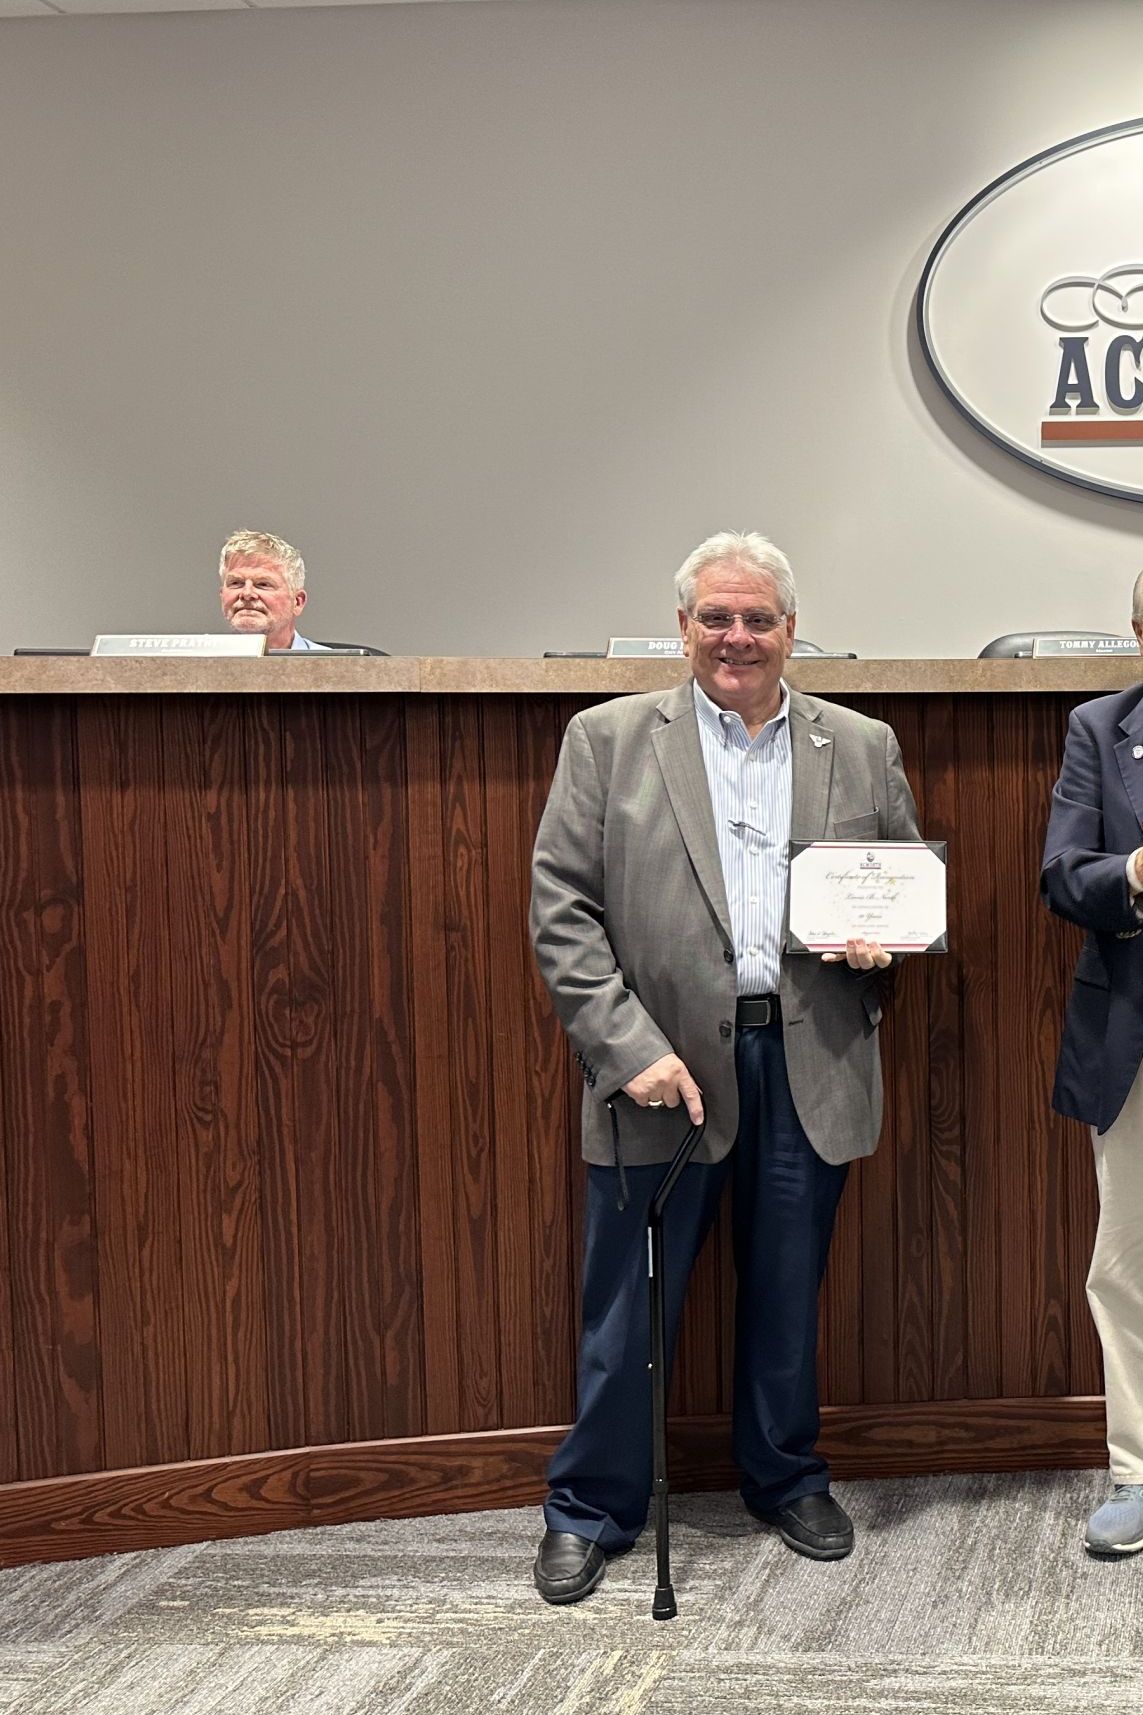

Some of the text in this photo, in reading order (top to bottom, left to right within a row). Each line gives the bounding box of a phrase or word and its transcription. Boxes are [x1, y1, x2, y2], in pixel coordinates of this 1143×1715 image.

[129, 638, 169, 648] STEVE
[647, 641, 677, 650] DOUG
[1060, 640, 1096, 648] TOMMY
